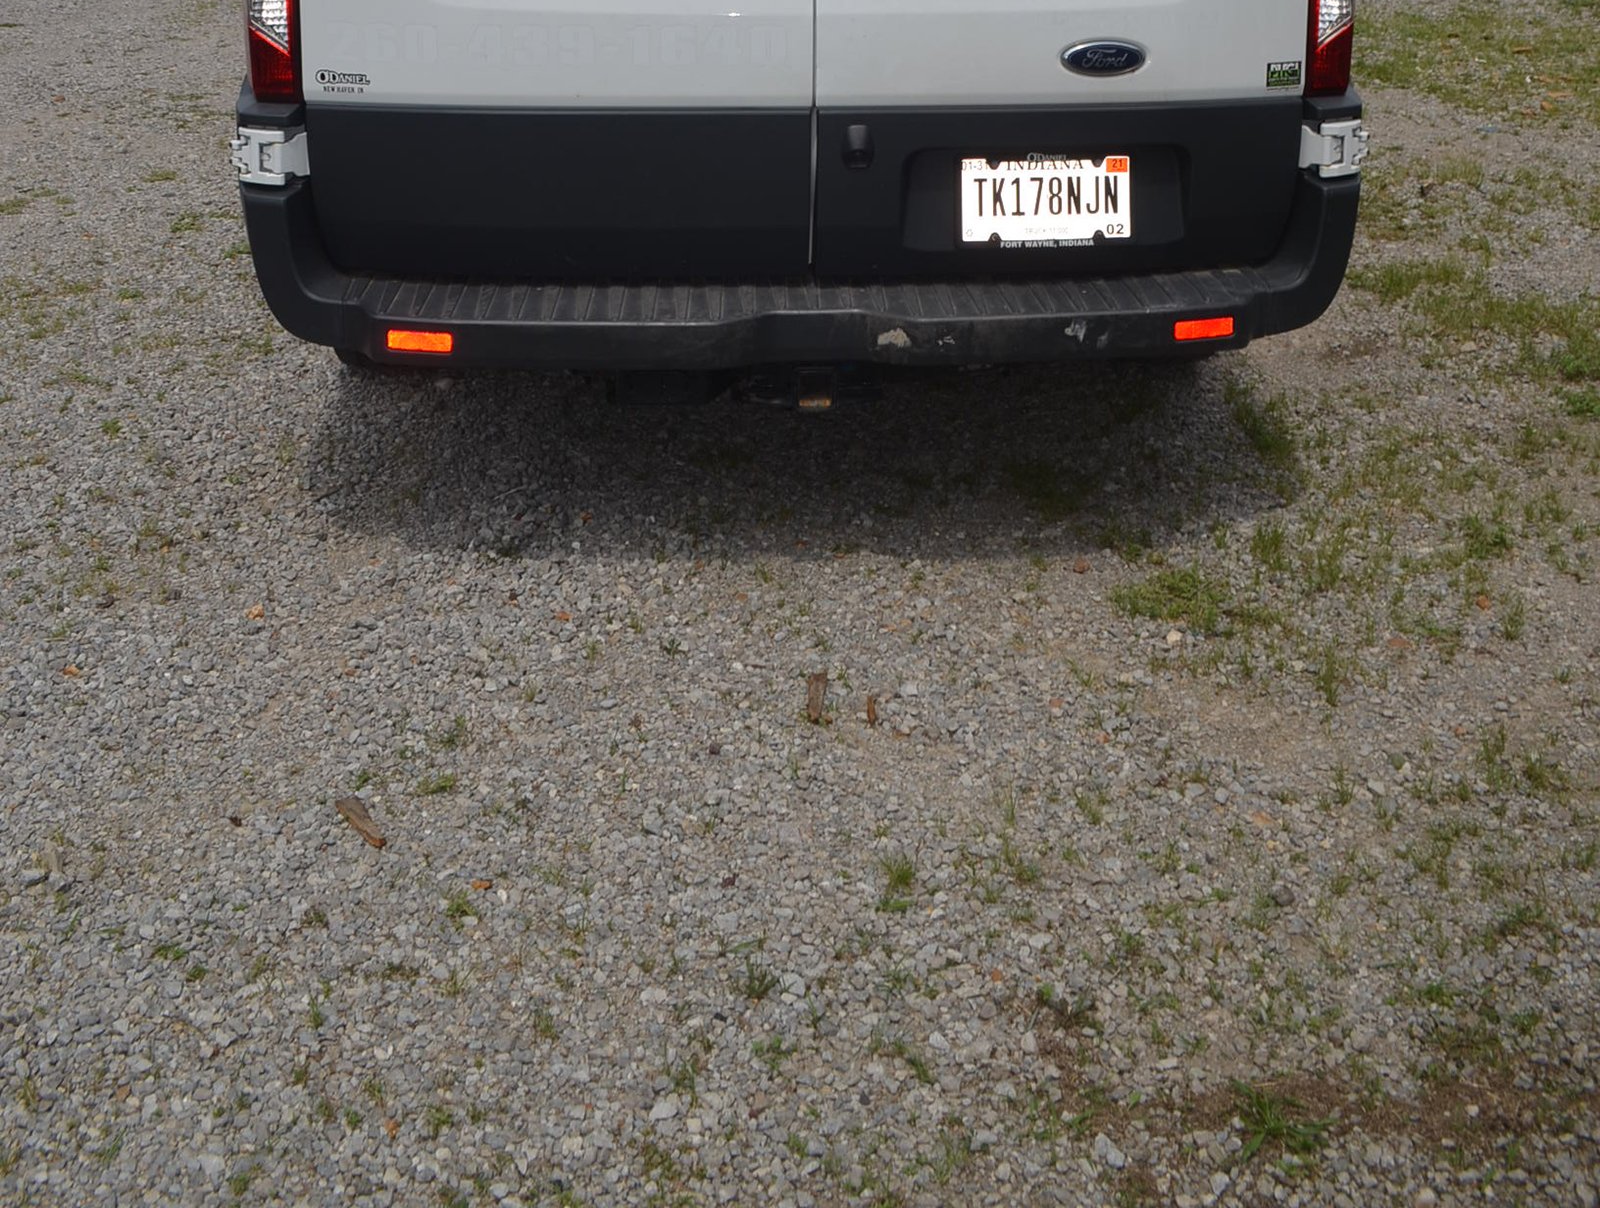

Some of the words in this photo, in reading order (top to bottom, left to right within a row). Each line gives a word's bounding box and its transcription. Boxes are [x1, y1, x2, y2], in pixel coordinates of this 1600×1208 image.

[1081, 48, 1129, 68] Ford
[1006, 159, 1085, 171] INDIANA
[1112, 158, 1124, 168] 21
[974, 175, 1119, 217] TK178NJN
[1106, 223, 1125, 235] 02
[1000, 240, 1024, 249] FORT
[1025, 239, 1058, 249] WAYNE,
[1059, 239, 1095, 248] INDIANA
